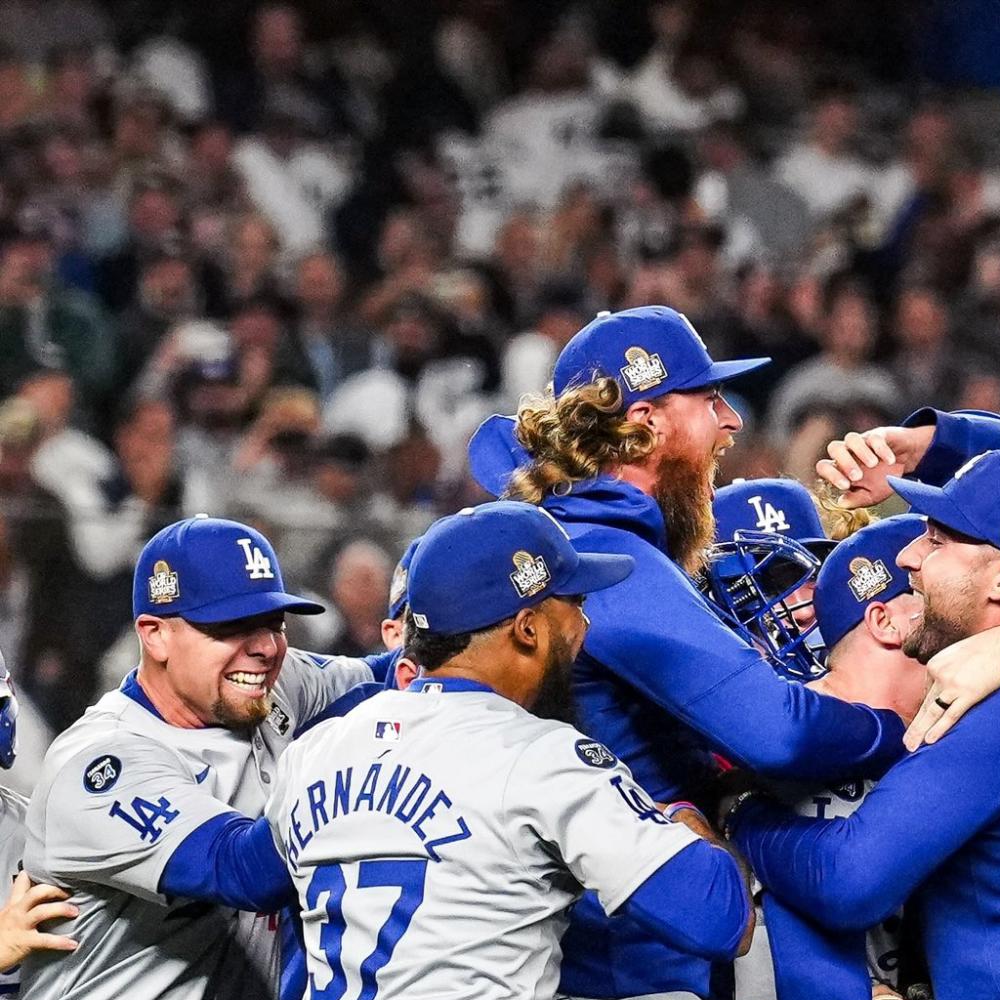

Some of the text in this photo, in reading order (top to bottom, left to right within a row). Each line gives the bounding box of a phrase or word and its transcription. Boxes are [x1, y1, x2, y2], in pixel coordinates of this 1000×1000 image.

[748, 496, 790, 533] LA
[237, 538, 274, 579] LA
[91, 763, 116, 789] 34
[109, 796, 180, 844] LA
